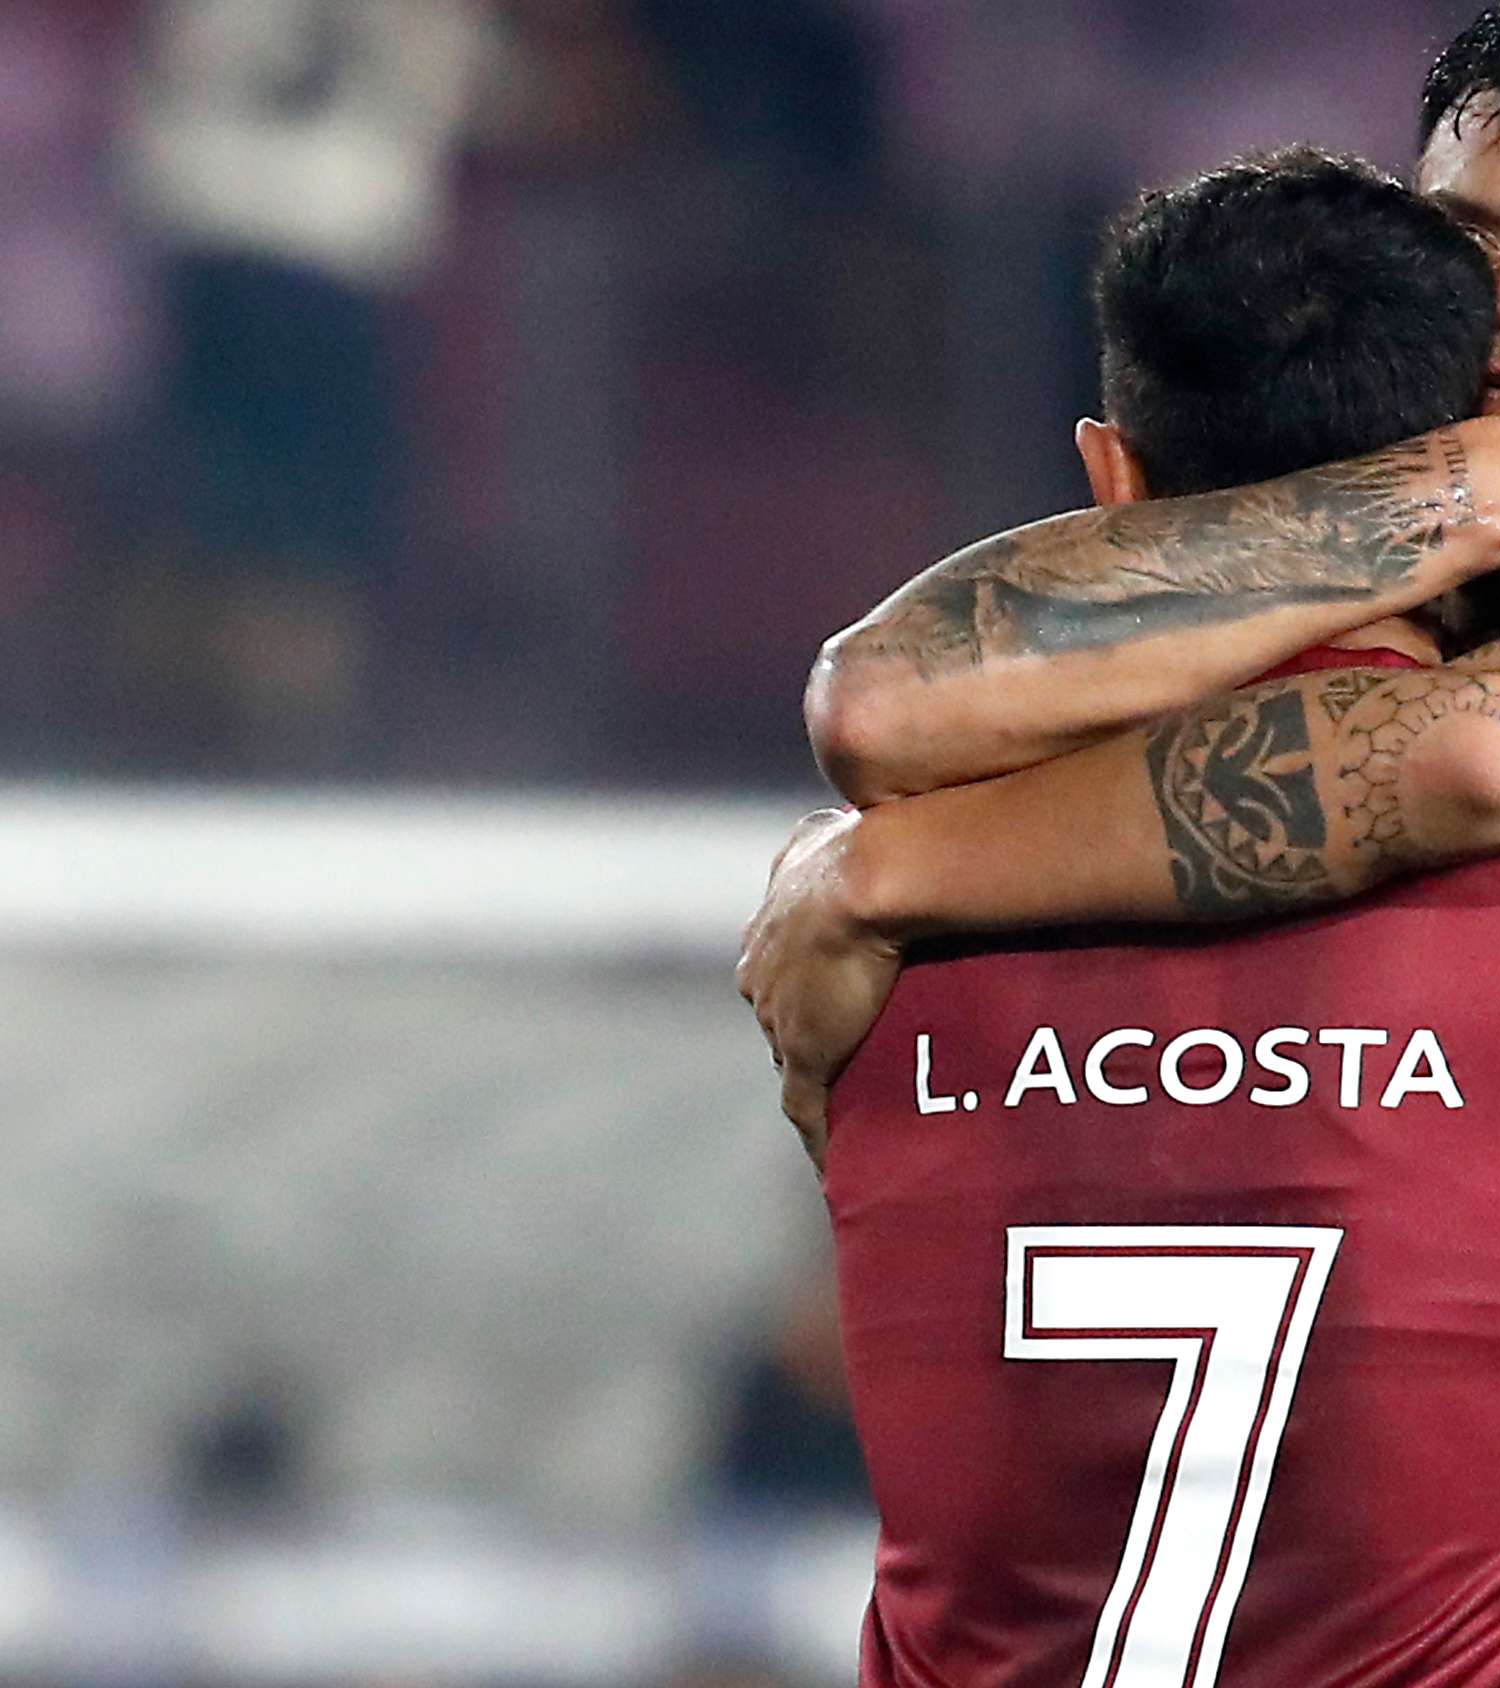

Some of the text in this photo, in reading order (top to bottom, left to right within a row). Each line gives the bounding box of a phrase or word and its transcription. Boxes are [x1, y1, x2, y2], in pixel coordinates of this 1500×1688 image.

[915, 1027, 1465, 1114] L. ACOSTA
[1004, 1225, 1345, 1688] 7
